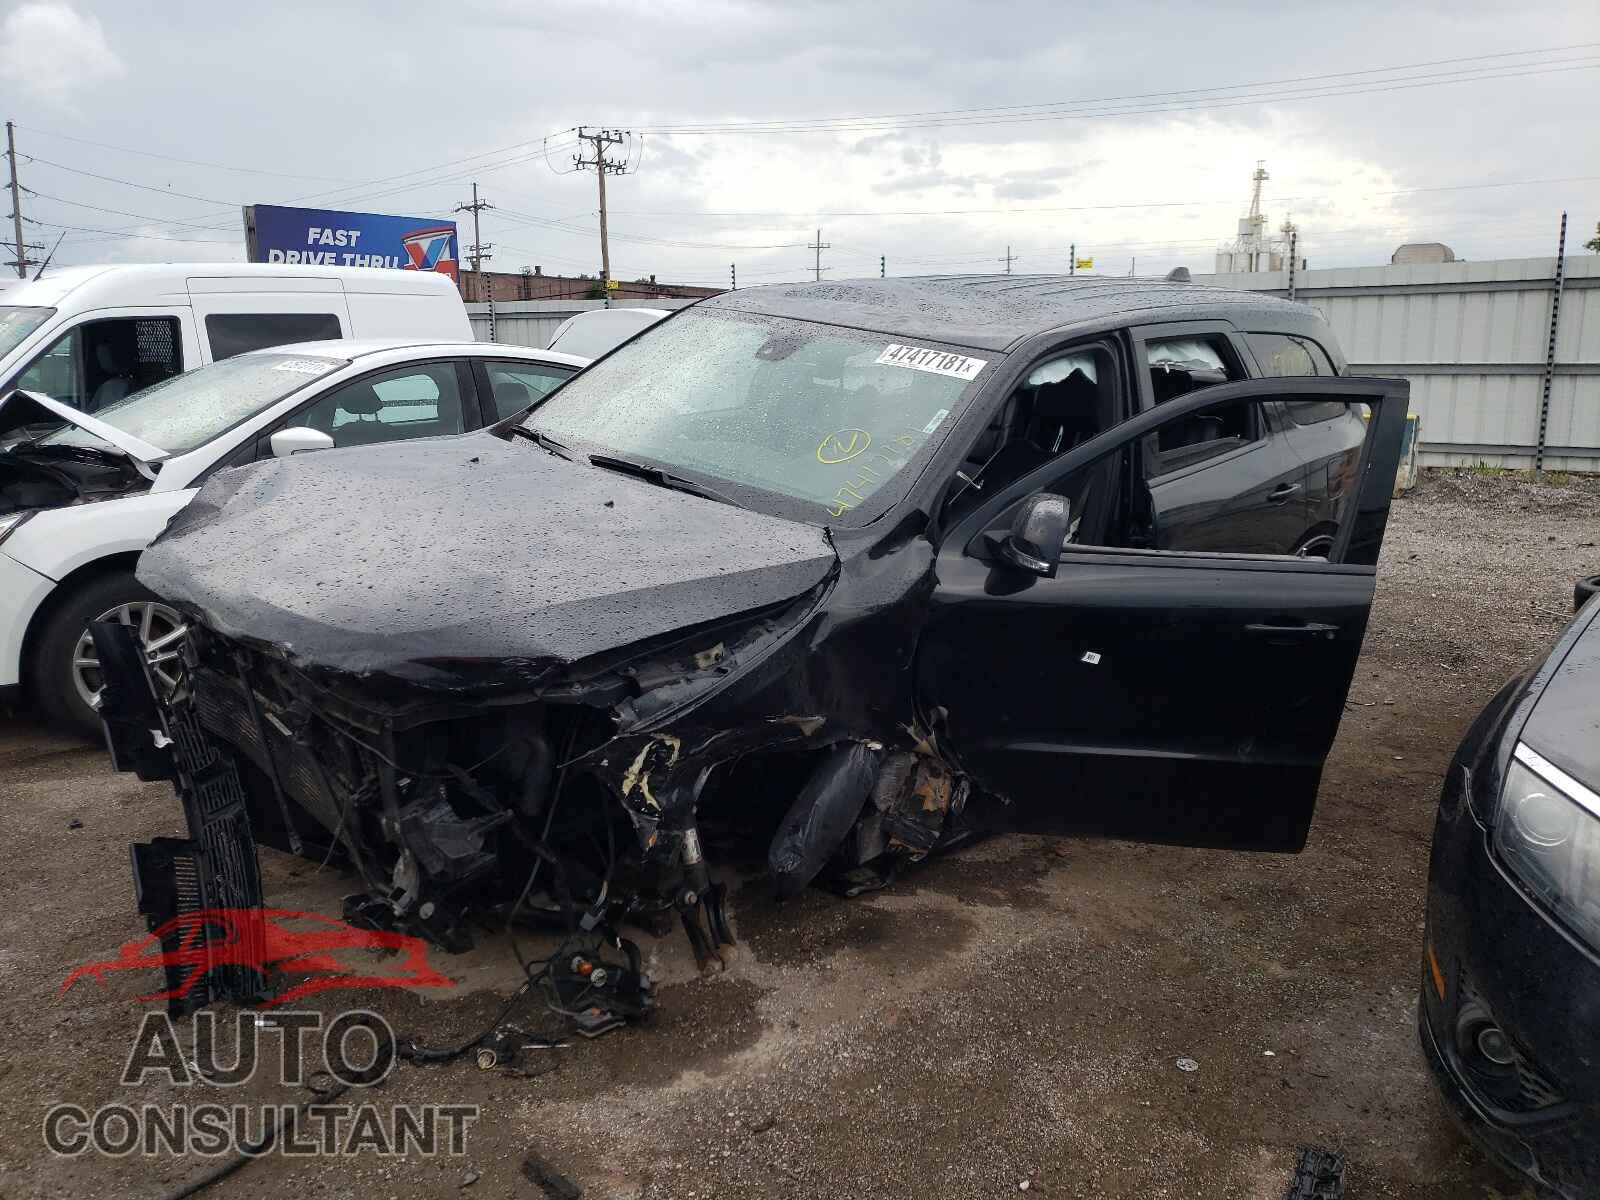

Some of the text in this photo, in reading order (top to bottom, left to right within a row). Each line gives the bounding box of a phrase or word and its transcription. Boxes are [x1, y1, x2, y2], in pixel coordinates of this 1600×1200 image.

[307, 227, 361, 247] FAST
[268, 249, 399, 269] DRIVE THRU
